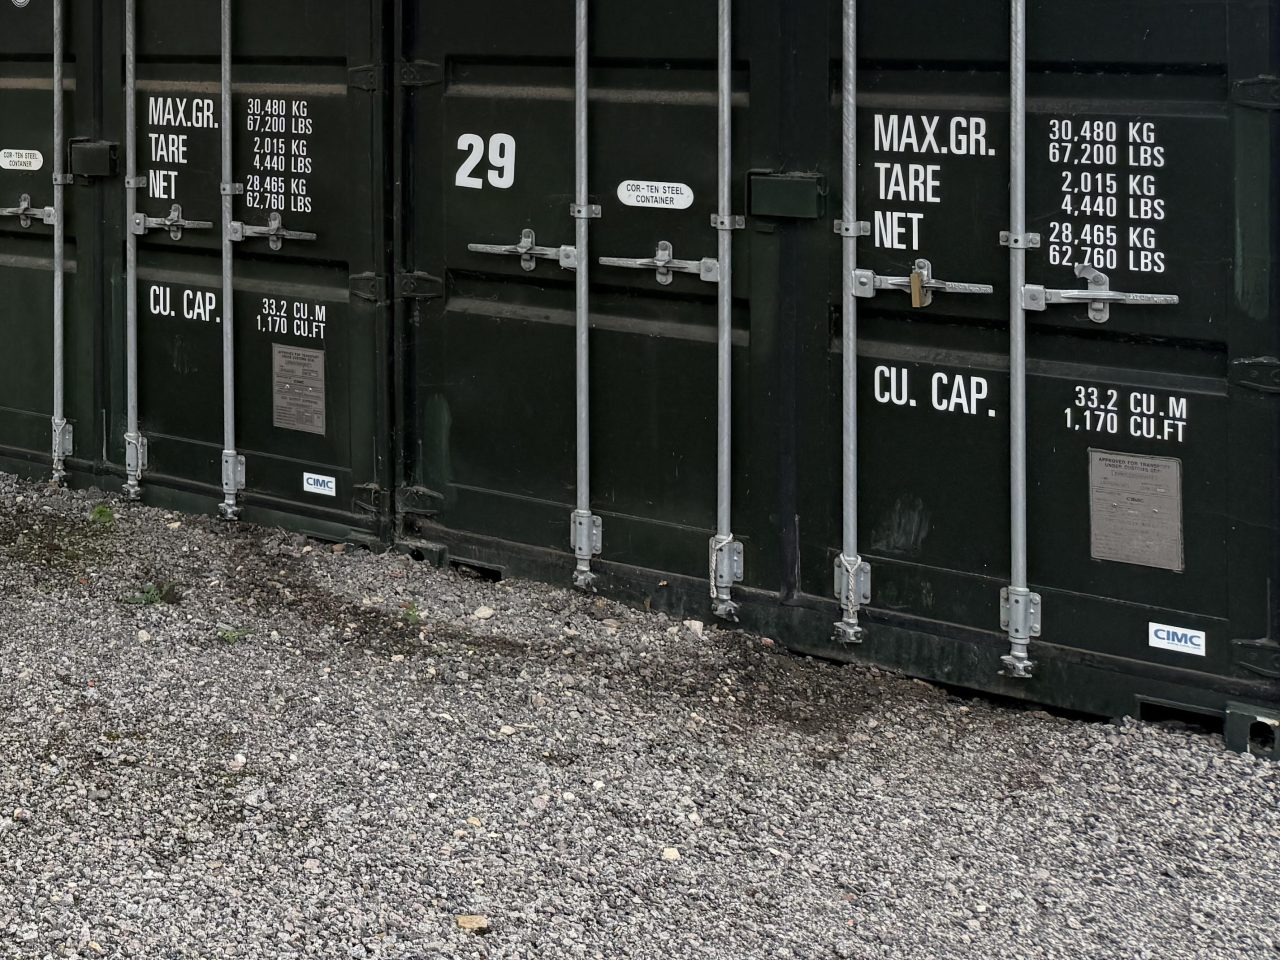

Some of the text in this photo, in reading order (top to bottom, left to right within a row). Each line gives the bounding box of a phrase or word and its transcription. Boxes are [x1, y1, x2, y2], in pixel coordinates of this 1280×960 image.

[149, 97, 218, 128] MAX.GR.
[248, 99, 307, 116] 30,480 KG
[247, 116, 312, 134] 67,200 LBS
[874, 115, 995, 155] MAX.GR.
[1049, 120, 1155, 142] 30,480 KG
[149, 134, 187, 163] TARE
[254, 137, 306, 156] 2,015 KG
[1049, 144, 1164, 167] 67,200 LBS
[254, 155, 311, 173] 4,440 LBS
[456, 132, 516, 190] 29
[149, 170, 178, 199] NET
[247, 175, 306, 195] 28,465 KG
[627, 184, 683, 194] COR-TEN STEEL
[875, 163, 940, 202] TARE
[1062, 172, 1155, 195] 2,015 KG
[247, 192, 311, 212] 62,760 LBS
[636, 195, 674, 205] CONTAINER
[1061, 195, 1164, 220] 4,440 LBS
[875, 211, 923, 250] NET
[1049, 223, 1155, 248] 28,465 KG
[1049, 247, 1164, 272] 62,760 LBS
[150, 286, 220, 323] CU. CAP.
[263, 299, 326, 321] 33.2 CU.M
[257, 315, 326, 339] 1,170 CU.FT
[874, 366, 995, 417] CU. CAP.
[1075, 386, 1186, 418] 33.2 CU.M
[1064, 408, 1186, 442] 1,170 CU.FT
[306, 476, 334, 490] CIMC
[1154, 629, 1200, 646] CIMC
